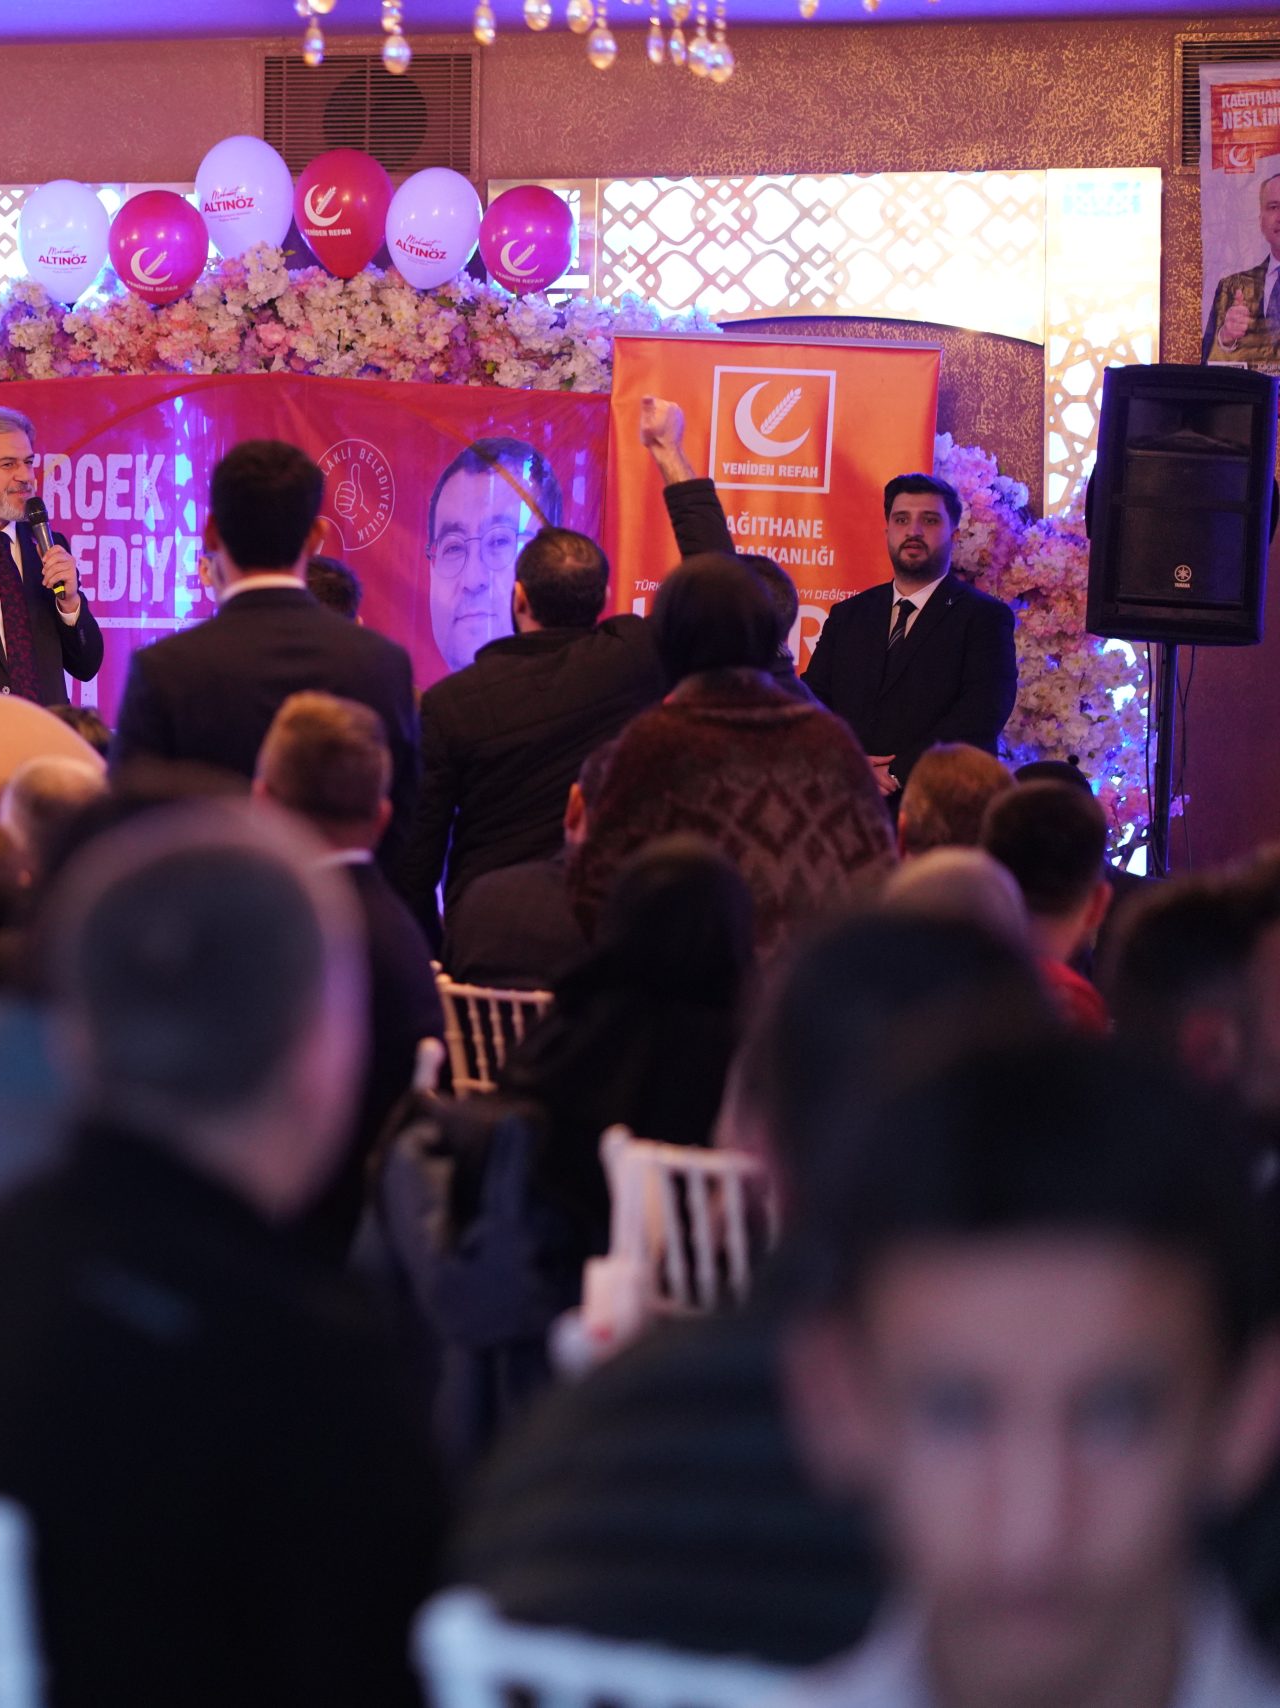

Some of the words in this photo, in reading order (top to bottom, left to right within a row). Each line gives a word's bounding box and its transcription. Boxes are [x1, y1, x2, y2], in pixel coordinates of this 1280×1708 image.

[1222, 108, 1280, 129] NESLİN
[204, 195, 255, 213] ALTINÖZ
[38, 254, 88, 265] ALTINÖZ
[395, 239, 448, 260] ALTINÖZ
[321, 446, 352, 477] LAKLI
[721, 460, 775, 477] YENİDEN
[778, 464, 819, 479] REFAH
[34, 453, 167, 531] RÇEK
[725, 511, 824, 539] AĞITHANE
